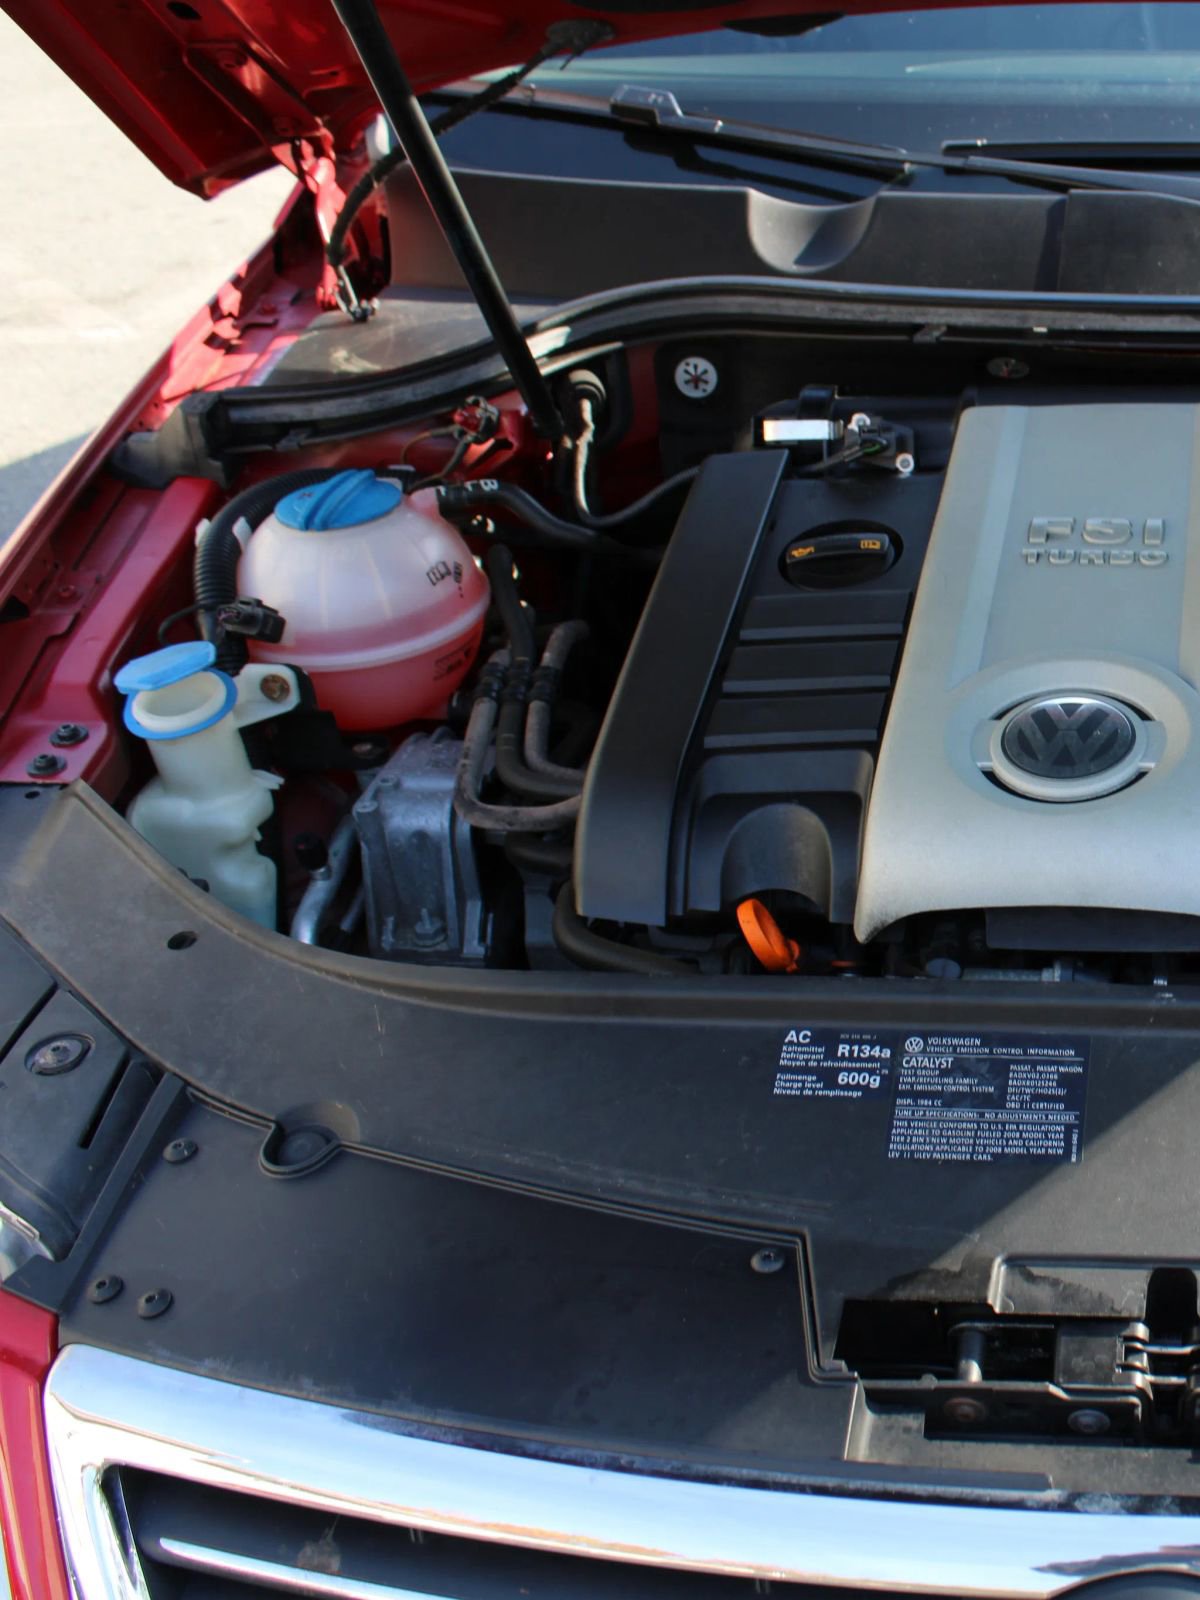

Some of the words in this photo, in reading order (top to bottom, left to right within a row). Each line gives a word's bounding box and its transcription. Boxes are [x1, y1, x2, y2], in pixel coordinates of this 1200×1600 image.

[1029, 517, 1164, 546] FSI
[1022, 548, 1169, 566] TURBO
[784, 1030, 812, 1044] AC
[927, 1037, 981, 1046] VOLKSWAGEN
[780, 1052, 824, 1060] Refrigerant
[837, 1044, 891, 1058] R134a
[902, 1057, 954, 1068] CATALYST
[838, 1072, 880, 1088] 600g
[815, 1090, 862, 1098] remplissage
